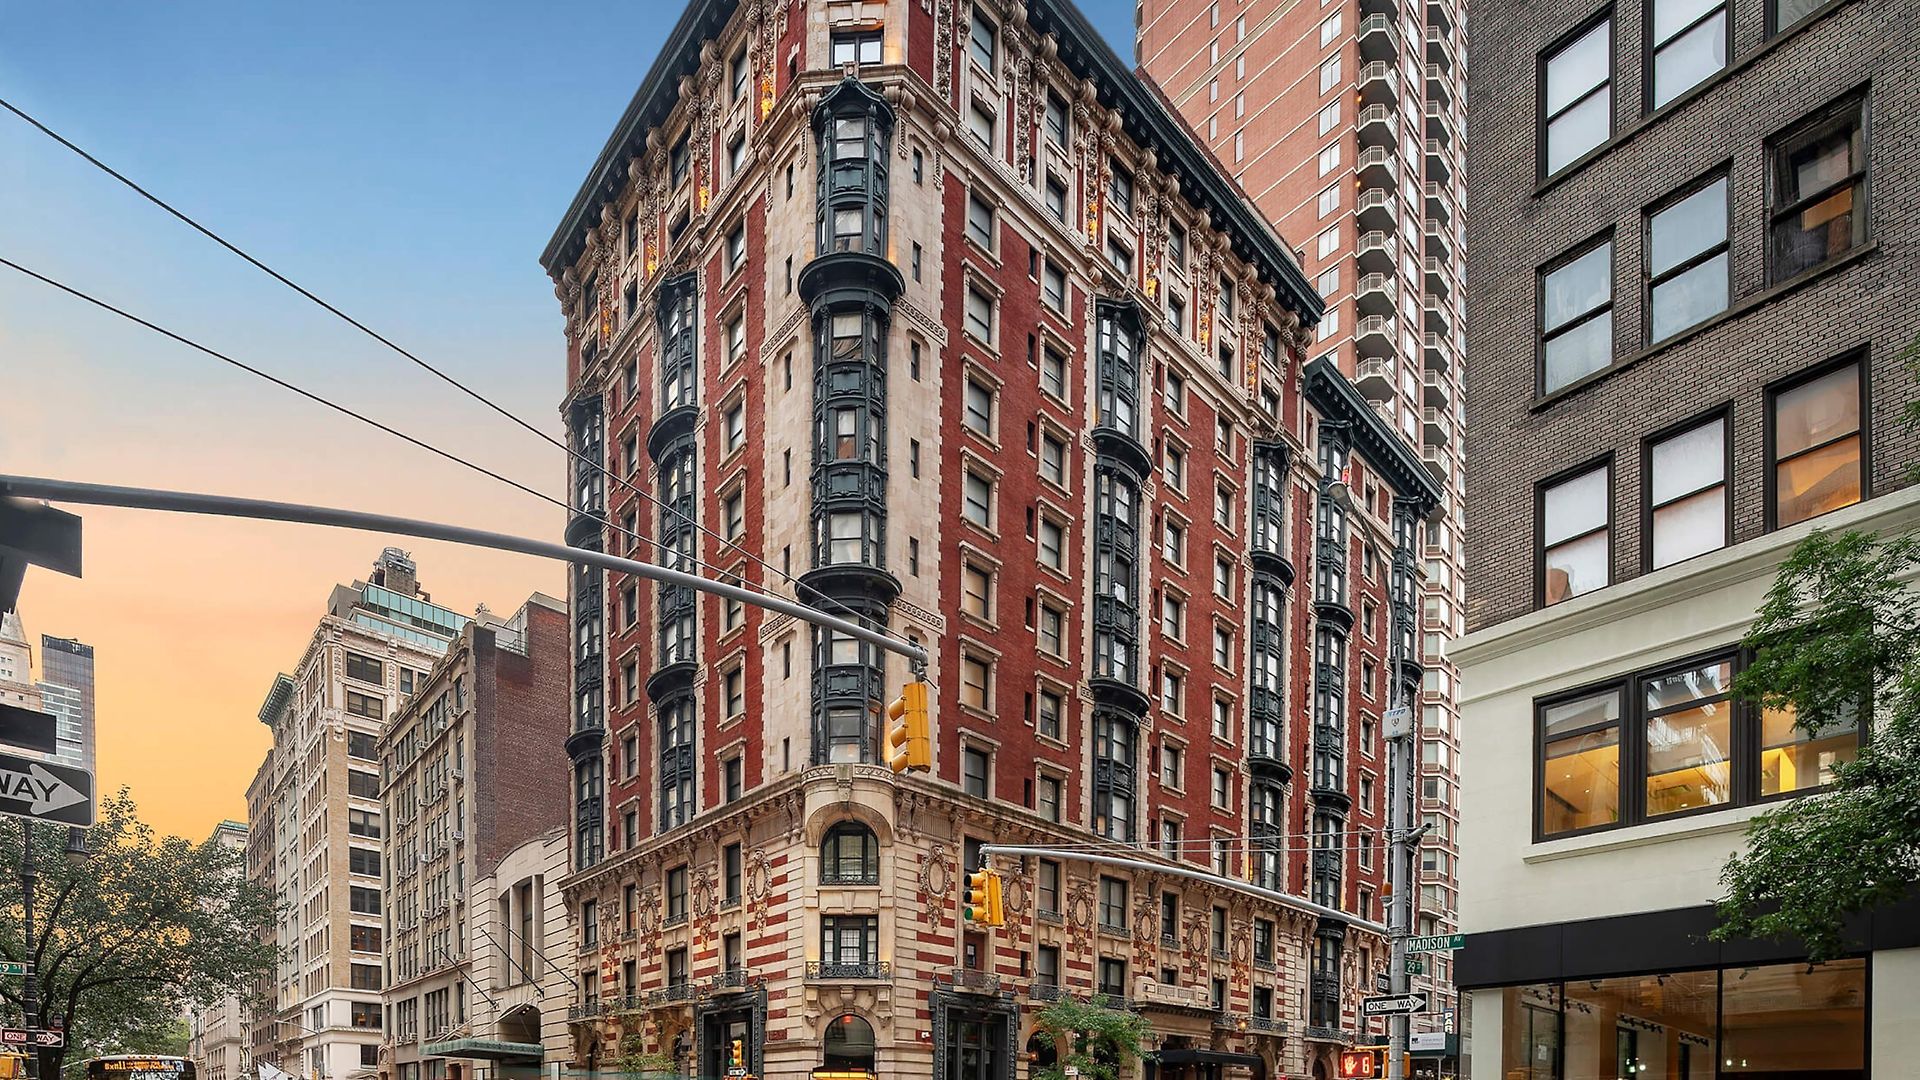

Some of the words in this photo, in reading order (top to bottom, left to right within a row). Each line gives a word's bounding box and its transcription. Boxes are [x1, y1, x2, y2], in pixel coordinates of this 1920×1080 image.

[1409, 937, 1450, 952] MADISON
[1407, 961, 1416, 973] 29
[1368, 1001, 1387, 1011] ONE
[1397, 999, 1418, 1009] WAY
